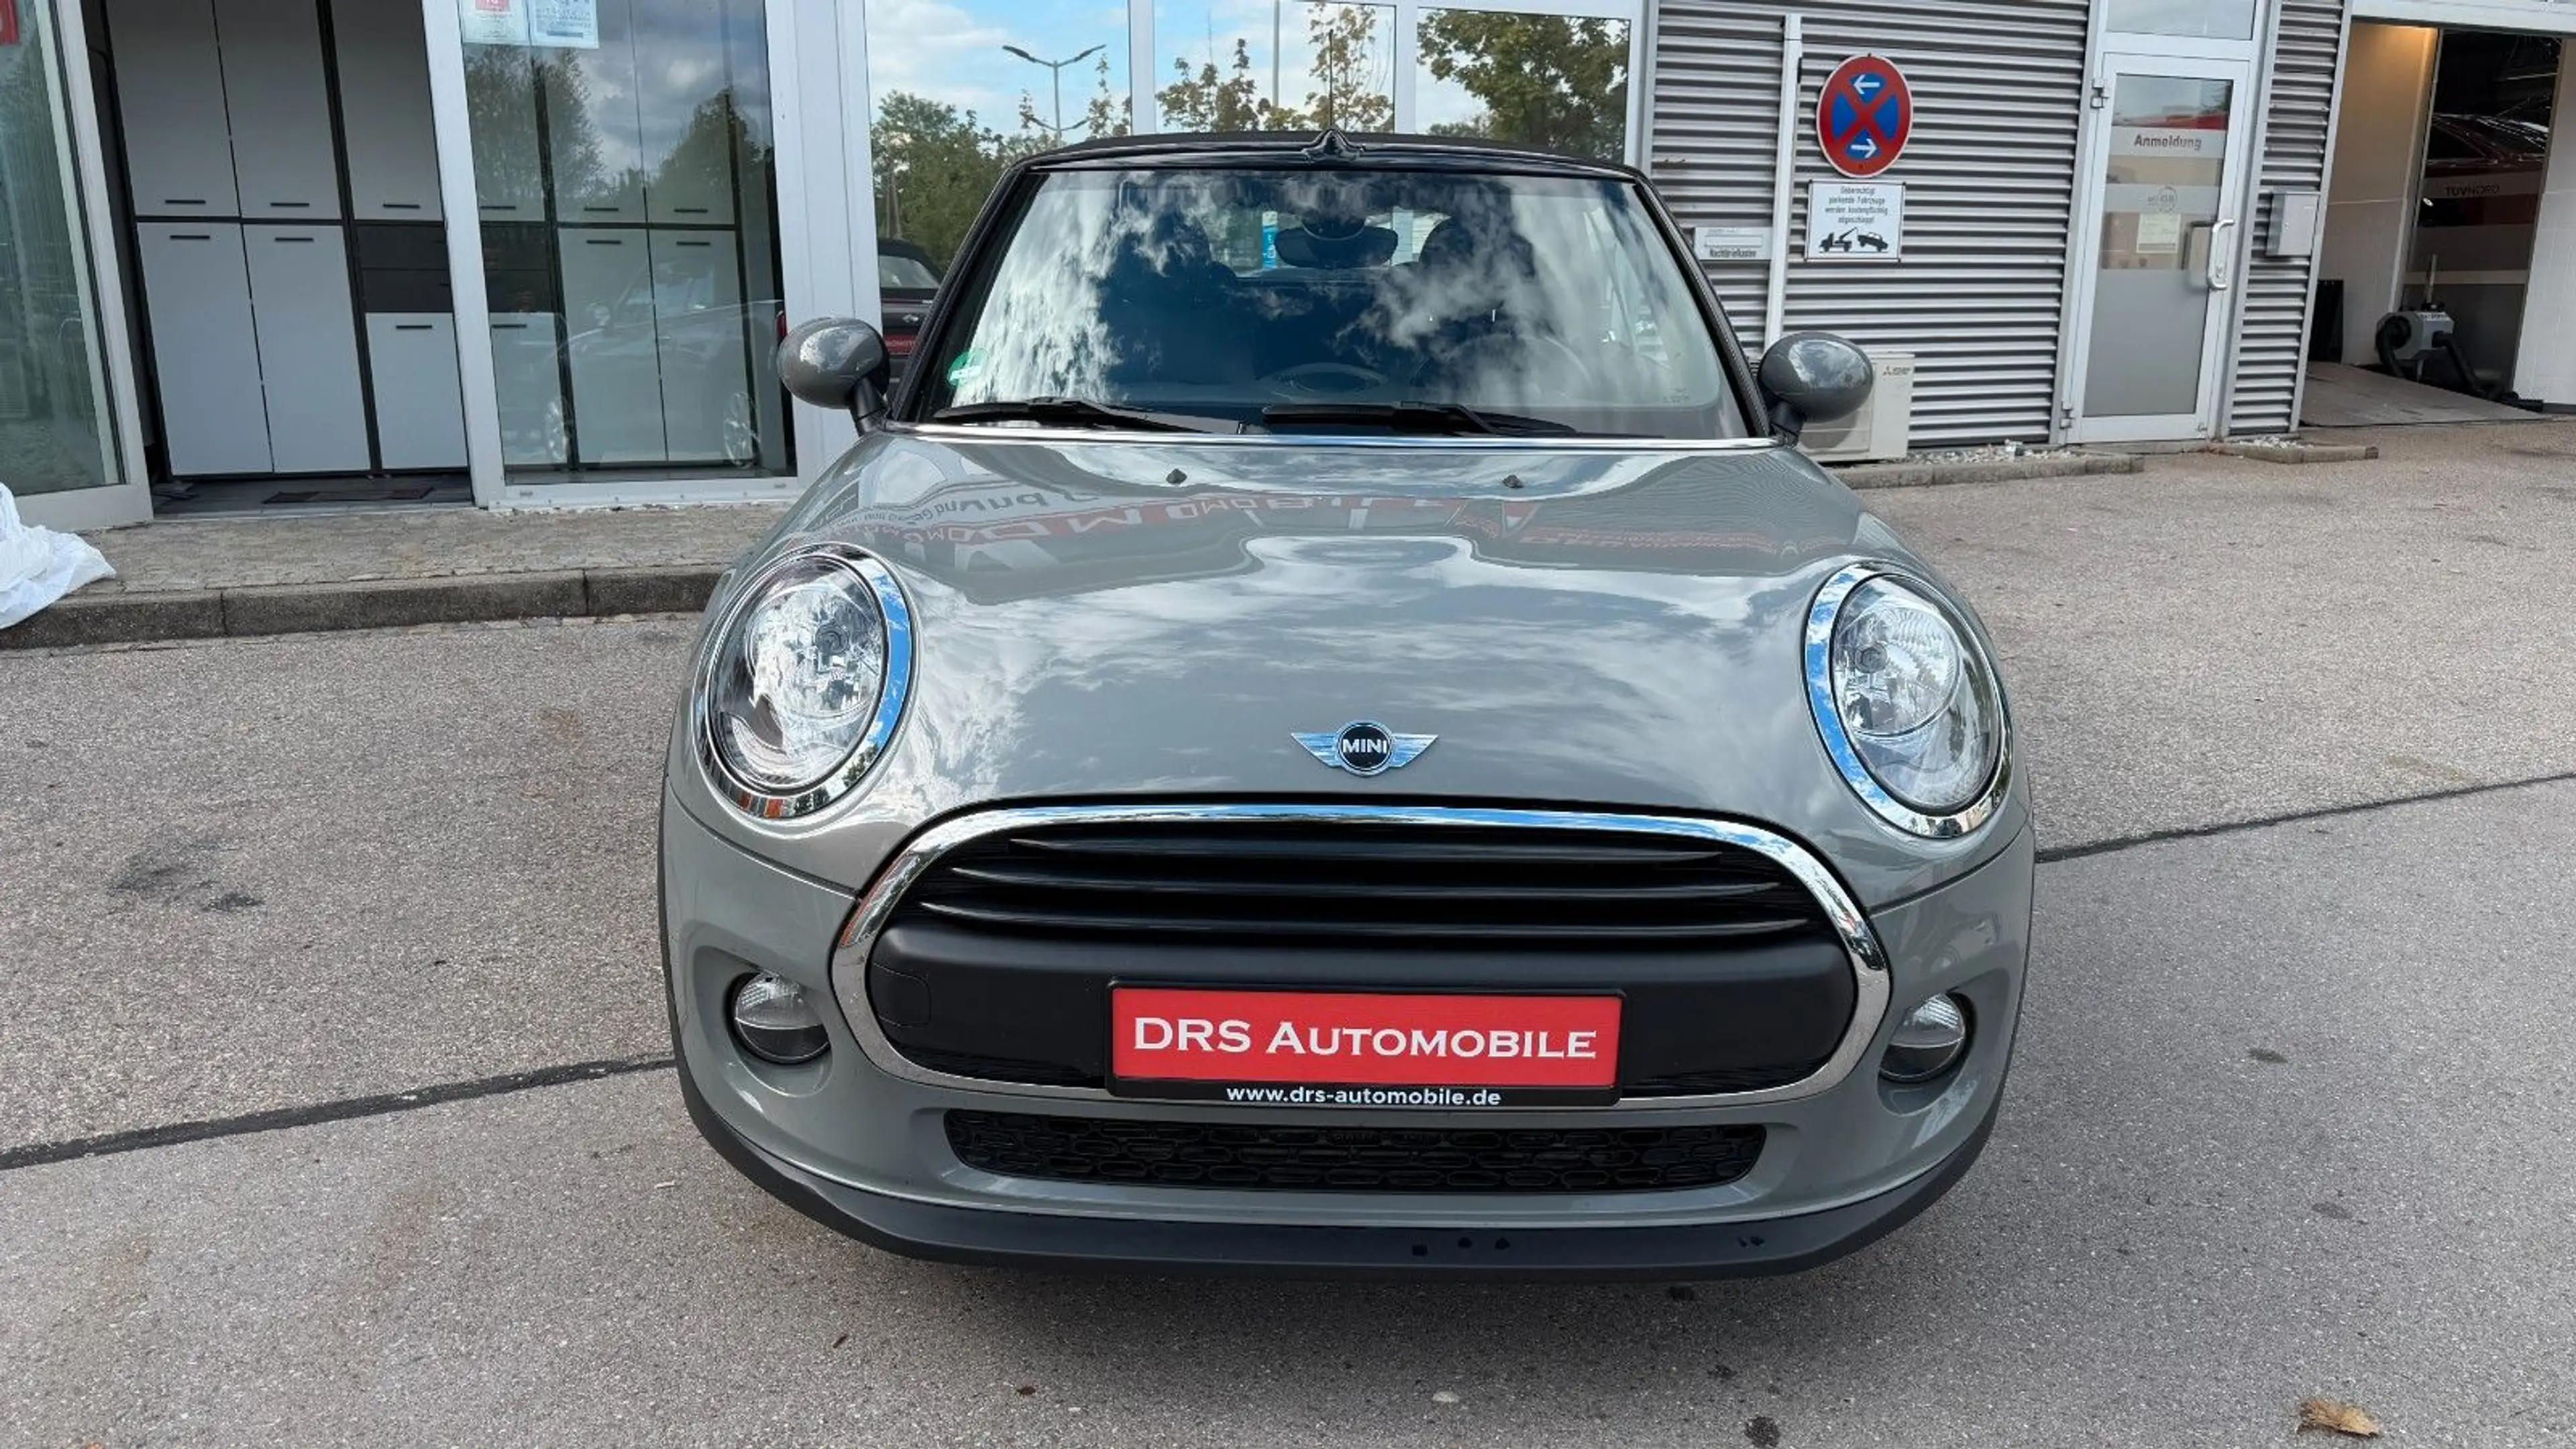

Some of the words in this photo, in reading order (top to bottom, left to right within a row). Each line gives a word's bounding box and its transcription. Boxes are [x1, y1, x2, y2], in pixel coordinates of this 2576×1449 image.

[2134, 134, 2202, 151] Anmeldung
[1342, 739, 1387, 754] MINI
[1134, 1016, 1251, 1053] DRS
[1266, 1021, 1597, 1059] AUTOMOBILE
[1226, 1085, 1502, 1108] www.drs-automobile.de
